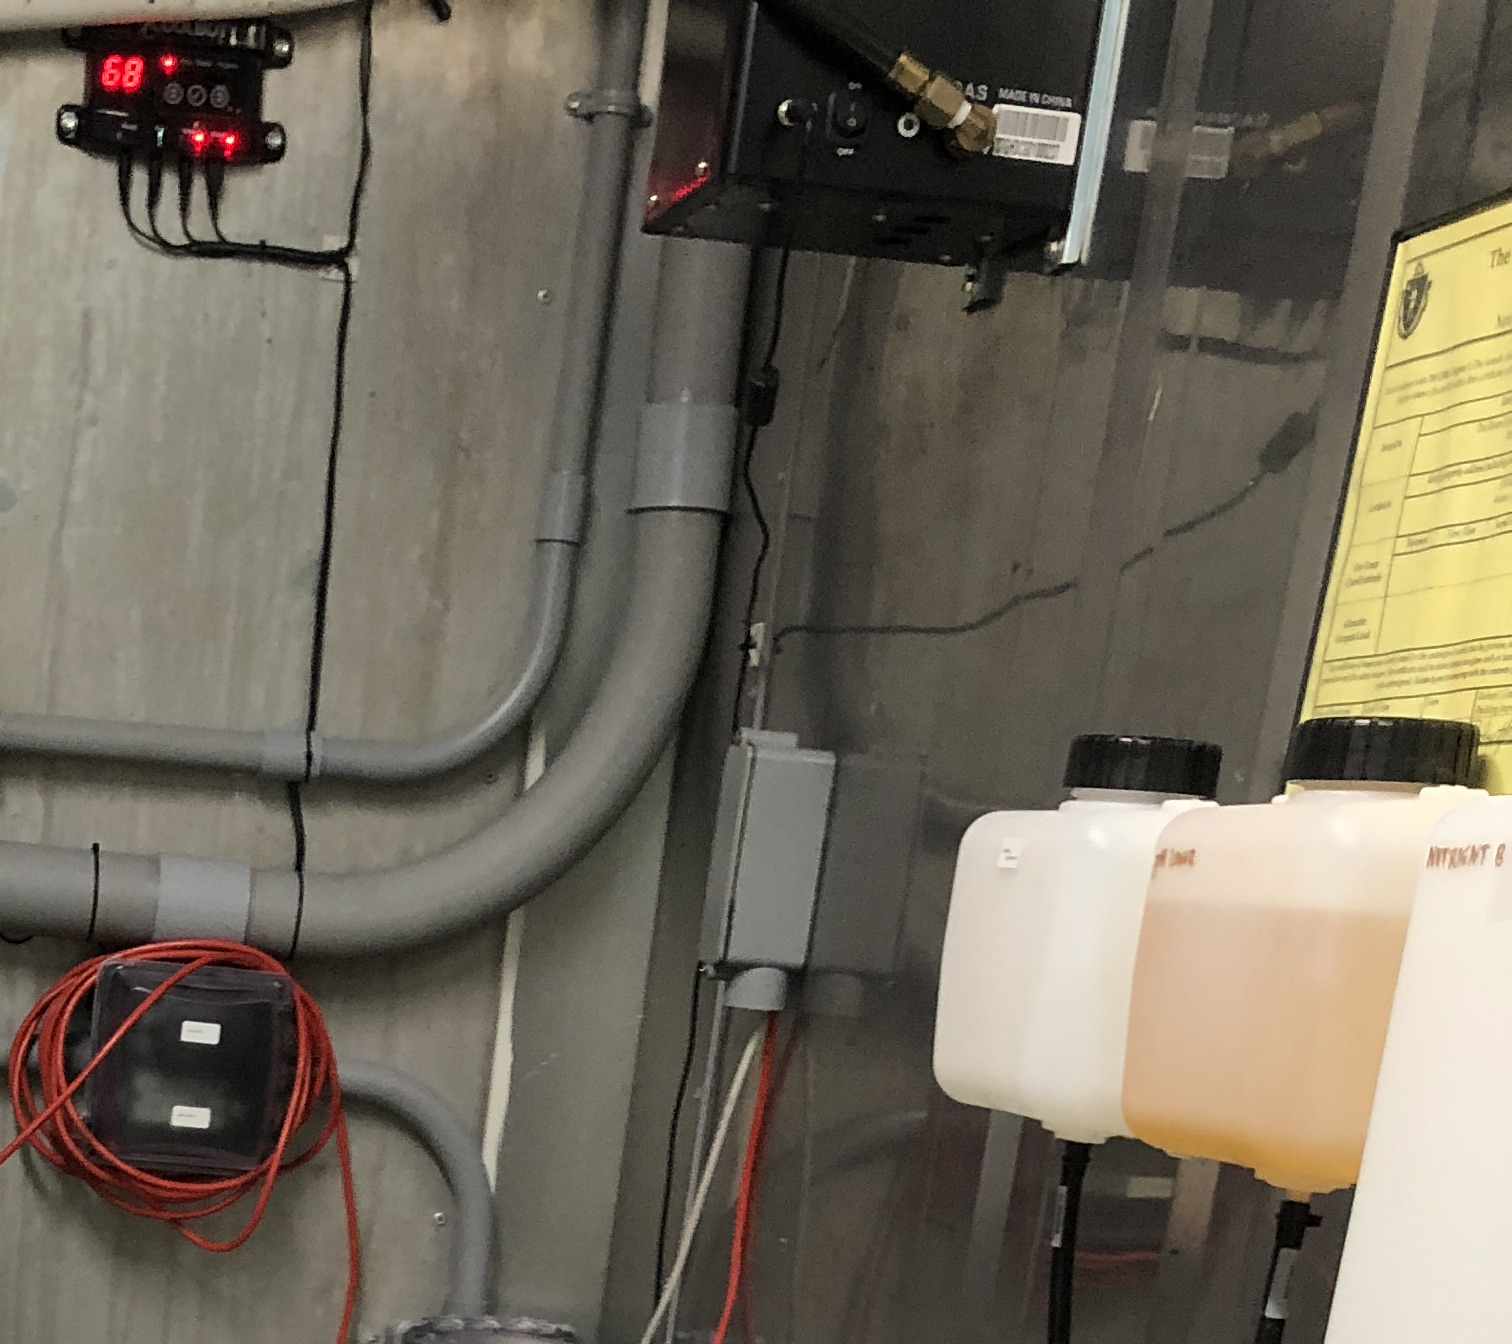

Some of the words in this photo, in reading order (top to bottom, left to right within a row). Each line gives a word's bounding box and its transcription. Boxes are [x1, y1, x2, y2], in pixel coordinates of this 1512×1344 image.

[101, 54, 144, 92] 68
[998, 87, 1027, 102] MADE
[1029, 92, 1040, 104] IN
[1041, 94, 1072, 109] CHINA
[1490, 246, 1511, 268] The
